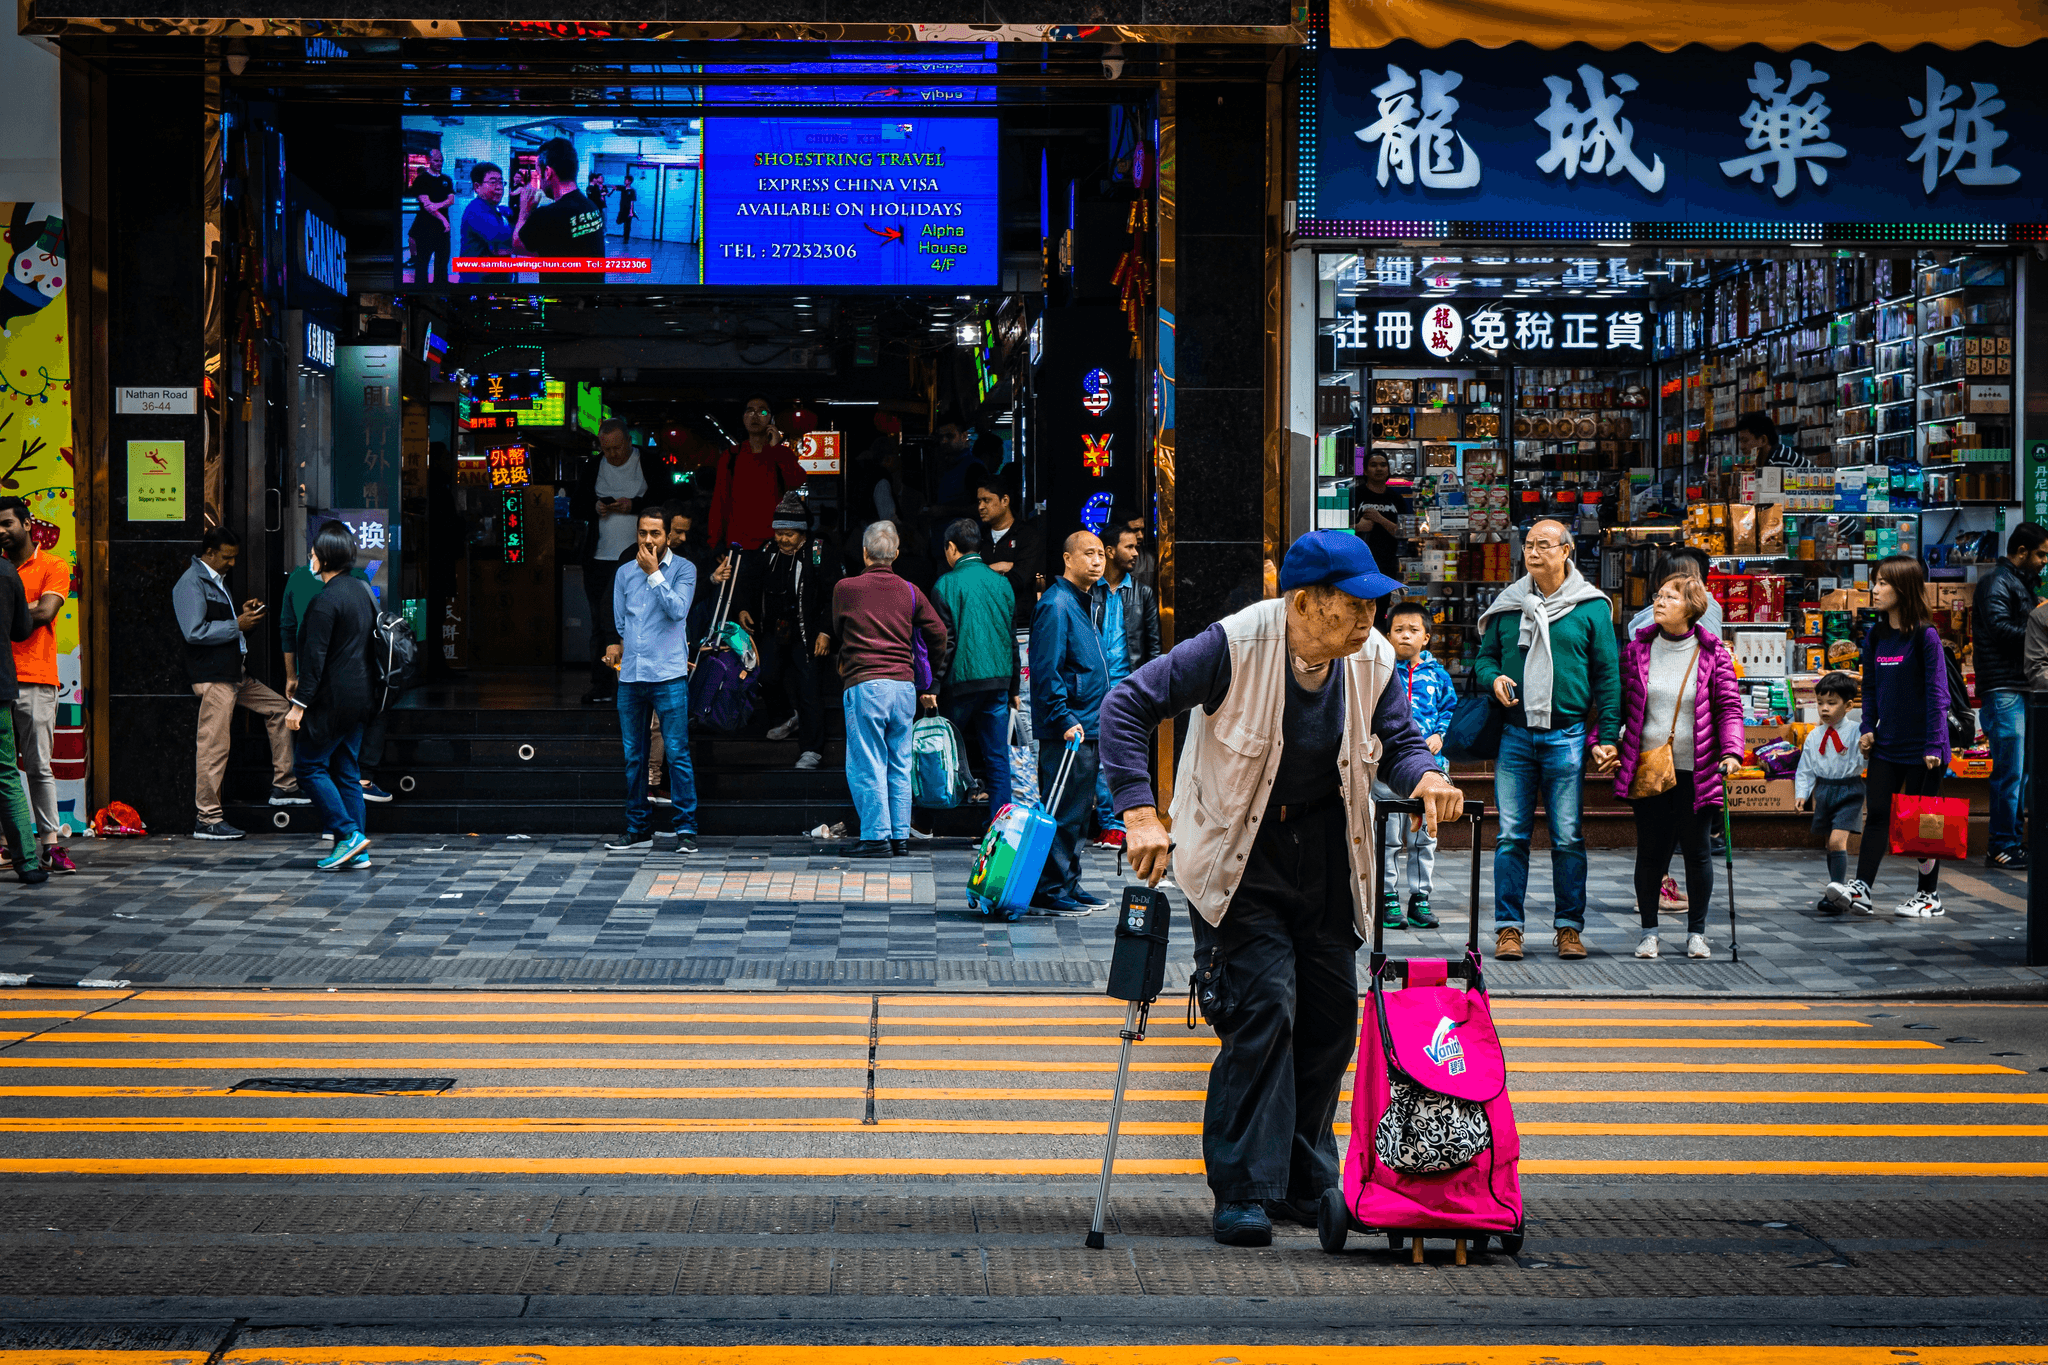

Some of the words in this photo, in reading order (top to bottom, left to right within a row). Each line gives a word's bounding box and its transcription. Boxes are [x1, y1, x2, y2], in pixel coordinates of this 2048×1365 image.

[1354, 59, 2022, 198] 龍城藥粧
[754, 152, 873, 167] SHOESTRING
[877, 152, 945, 167] TRAVEL
[758, 178, 829, 192] EXPRESS
[834, 178, 895, 192] CHINA
[899, 178, 939, 192] VISA
[737, 202, 831, 217] AVAILABLE
[835, 202, 864, 217] ON
[870, 202, 962, 217] HOLIDAYS
[921, 224, 965, 240] Alpha
[305, 209, 348, 297] CHANGE
[719, 244, 756, 258] TEL
[771, 244, 857, 259] 27232306
[918, 241, 968, 255] House
[586, 259, 603, 268] Tel:
[605, 259, 647, 268] 27232306
[931, 258, 956, 273] 4/F
[1431, 307, 1453, 352] 龍城
[1470, 310, 1645, 350] 免稅正貨
[125, 390, 160, 399] Nathan
[162, 390, 188, 399] Road
[142, 401, 171, 411] 36-44
[1736, 785, 1766, 795] 20KG
[1423, 1031, 1464, 1065] Vanis
